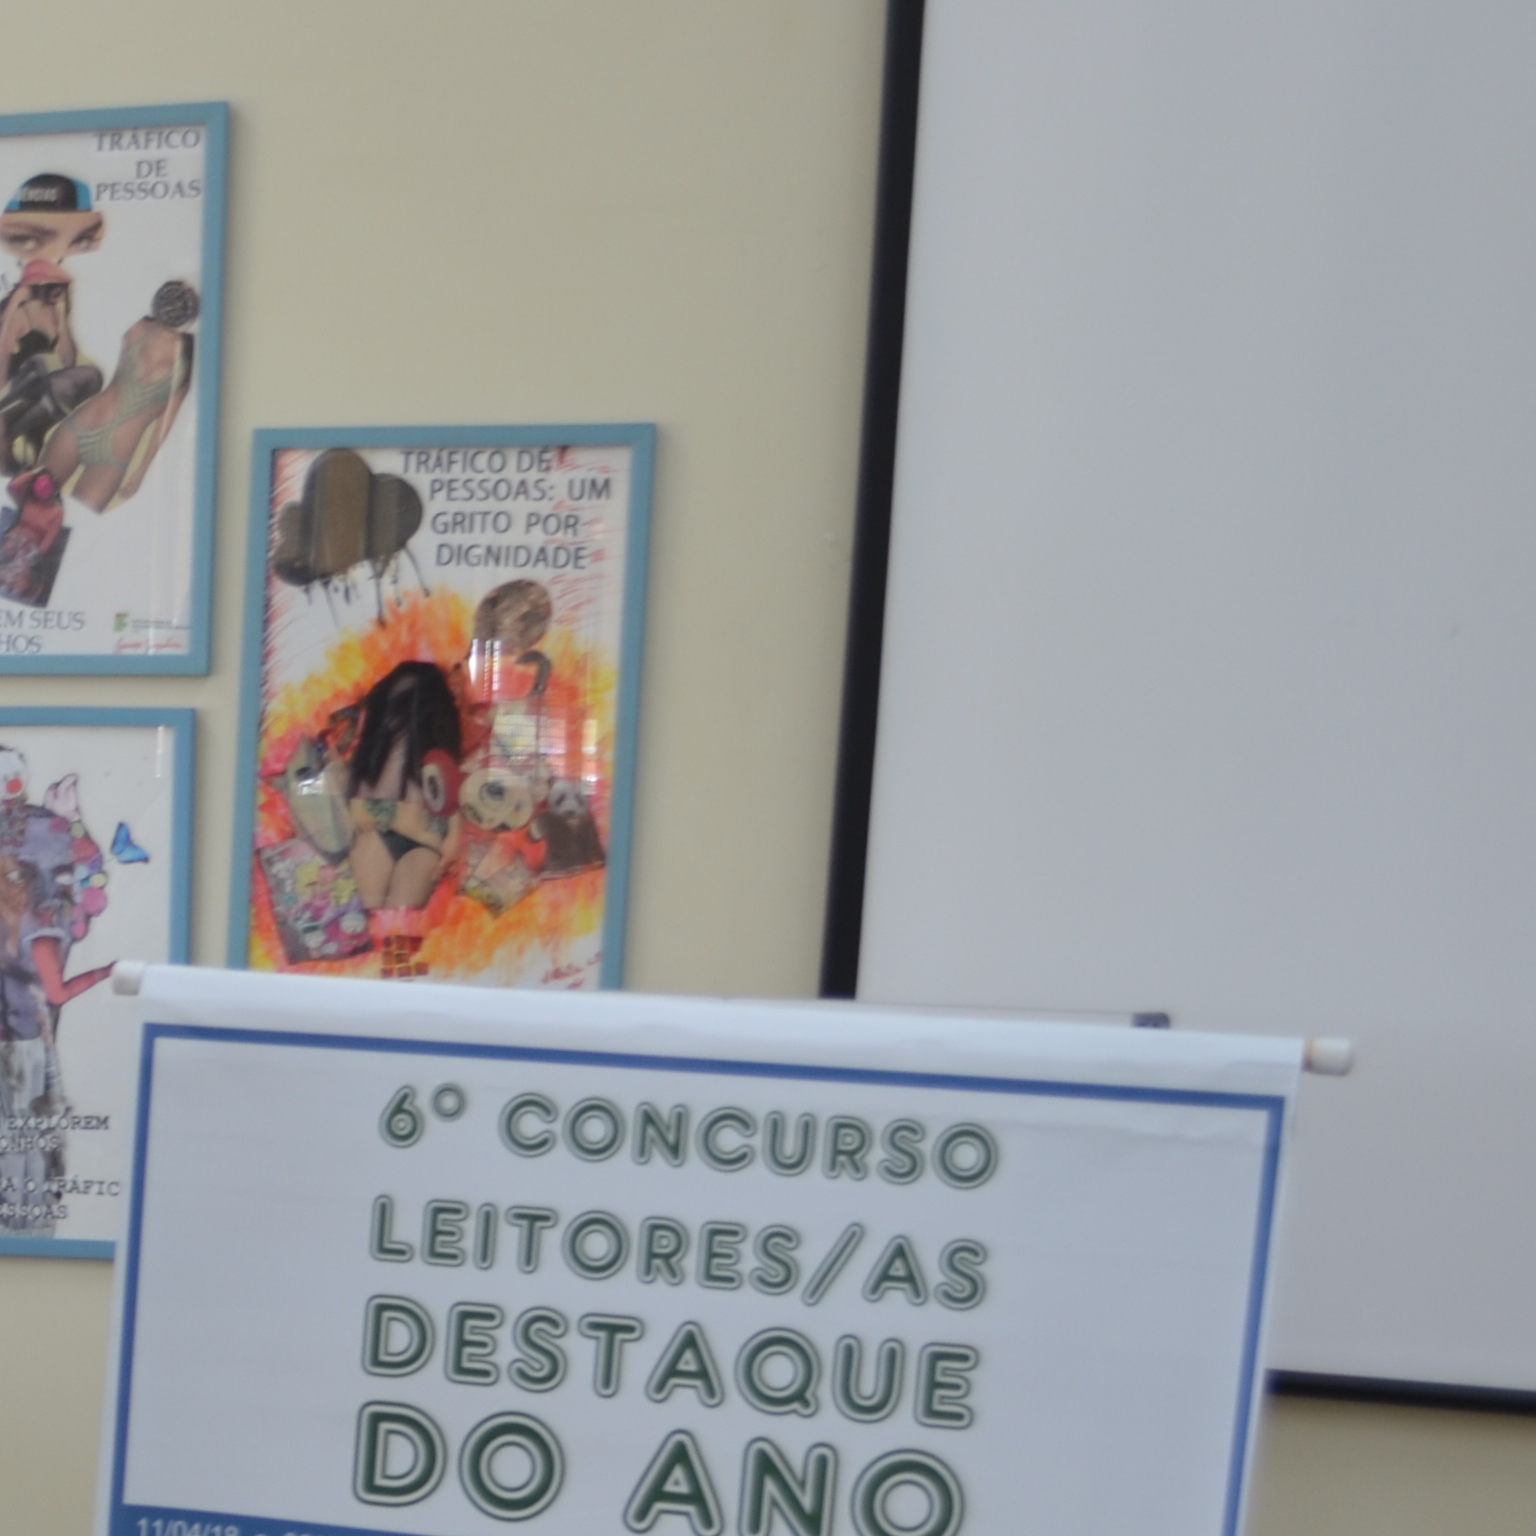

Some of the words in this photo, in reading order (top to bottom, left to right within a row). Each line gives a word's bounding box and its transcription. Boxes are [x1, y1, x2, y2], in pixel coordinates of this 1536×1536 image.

[94, 127, 200, 151] TRÁFICO
[135, 159, 168, 179] DE
[95, 179, 202, 201] PESSOAS
[401, 447, 507, 473] TRÁFICO
[430, 477, 555, 501] PESSOAS:
[568, 477, 612, 500] UM
[431, 510, 512, 534] GRITO
[526, 512, 579, 536] POR
[436, 543, 587, 570] DIGNIDADE
[30, 610, 86, 630] SEUS
[497, 1091, 999, 1190] CONCURSO
[24, 1178, 39, 1194] O
[369, 1193, 989, 1311] LEITORES/AS
[361, 1294, 979, 1430] DESTAQUE
[352, 1399, 564, 1522] DO
